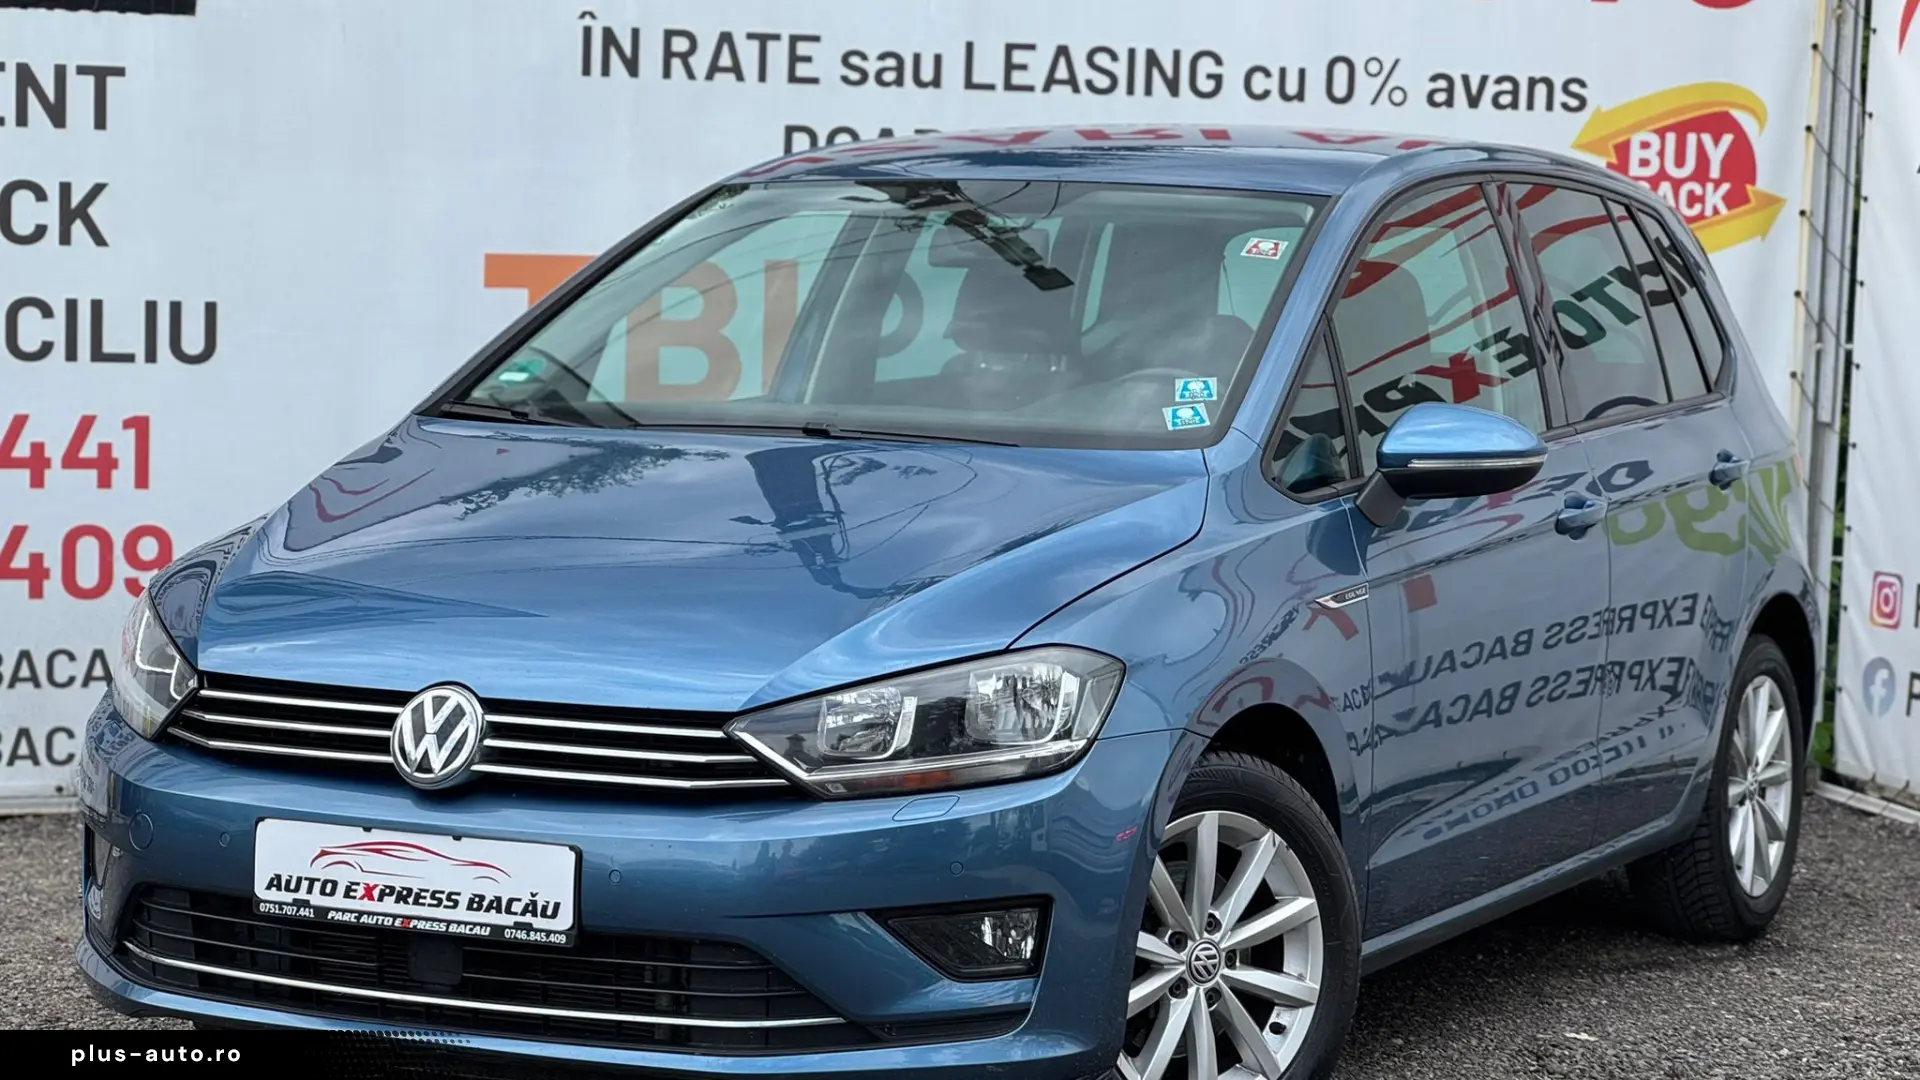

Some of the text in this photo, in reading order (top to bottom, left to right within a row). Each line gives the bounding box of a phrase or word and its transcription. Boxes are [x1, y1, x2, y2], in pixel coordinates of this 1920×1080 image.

[579, 12, 1588, 113] ÎN RATE sau LEASING cu 0% avans
[1628, 129, 1734, 179] BUY
[1636, 179, 1732, 218] ACK
[259, 902, 315, 918] 0751.707.441
[264, 873, 561, 920] AUTO EXPRESS BACĂU
[327, 910, 491, 936] PARC AUTO EXPRESS BACAU
[504, 928, 567, 944] 0746.845.409
